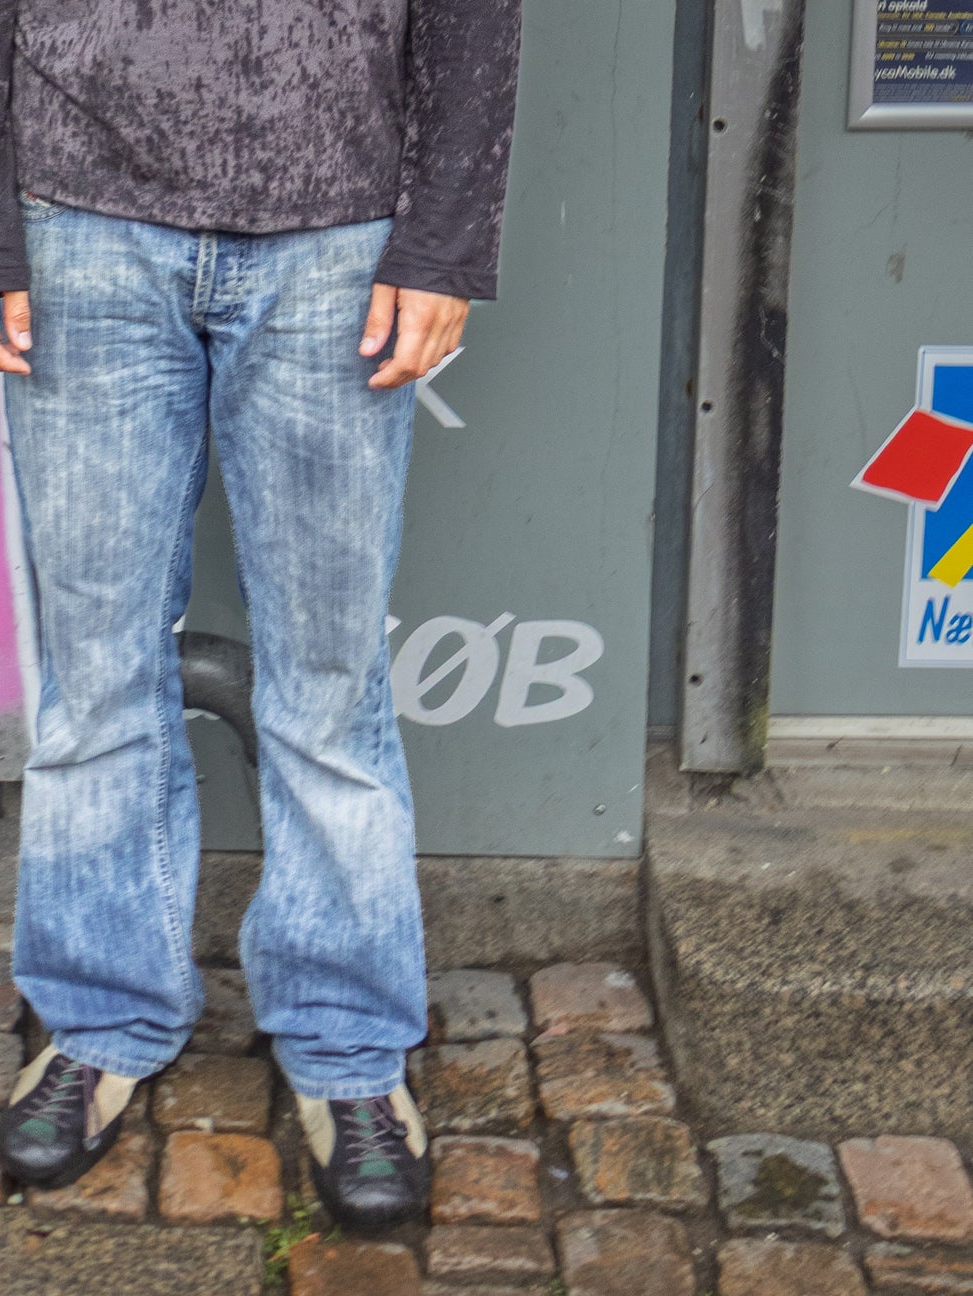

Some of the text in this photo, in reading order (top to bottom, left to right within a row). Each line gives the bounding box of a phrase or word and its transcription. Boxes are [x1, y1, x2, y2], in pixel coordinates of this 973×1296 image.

[888, 0, 928, 13] opkald
[874, 65, 956, 82] ycaMobile.dk
[386, 611, 605, 728] ØB
